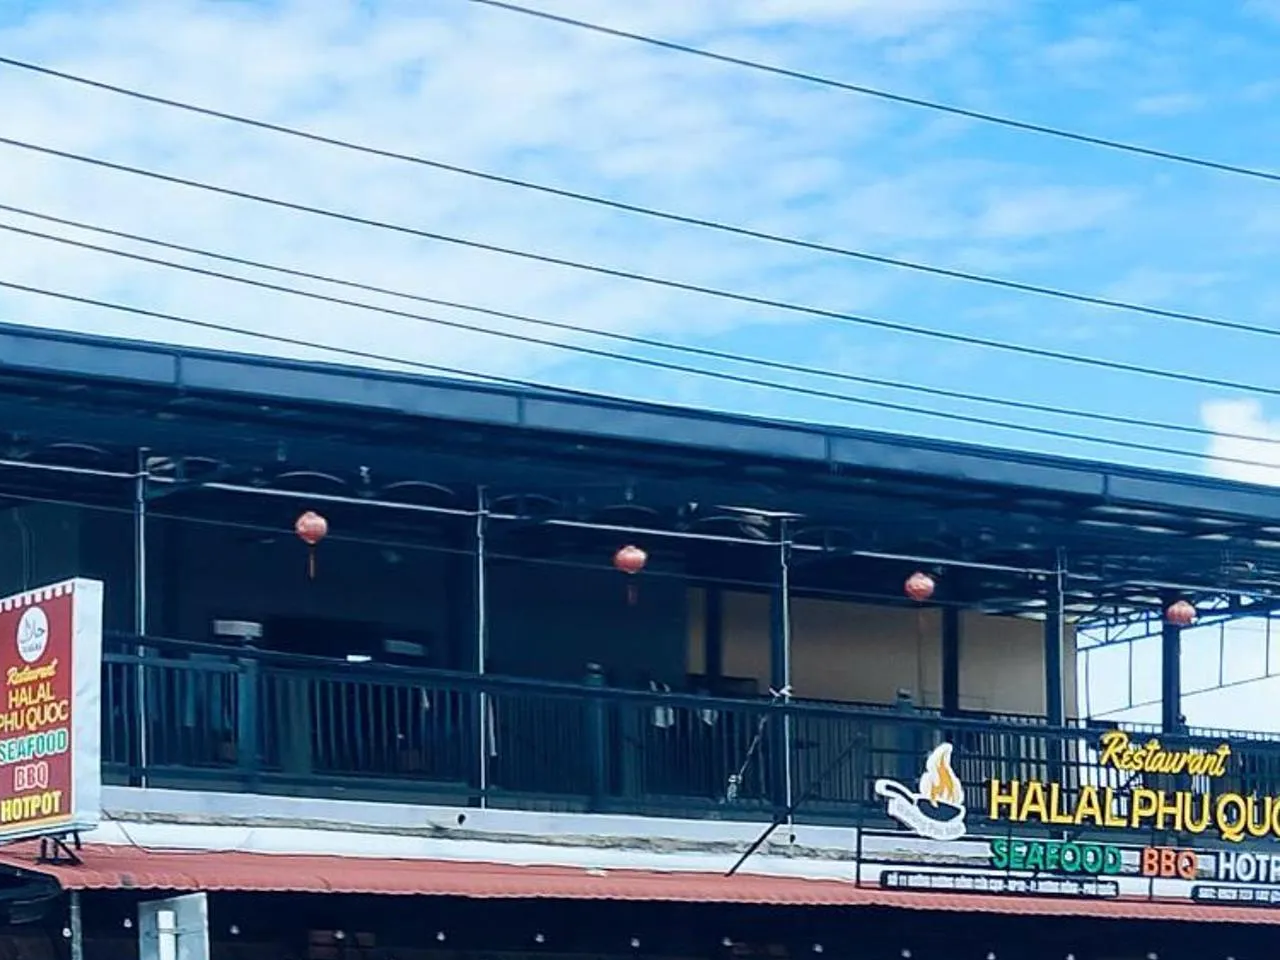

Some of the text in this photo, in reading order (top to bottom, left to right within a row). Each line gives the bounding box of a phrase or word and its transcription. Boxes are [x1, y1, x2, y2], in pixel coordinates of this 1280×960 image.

[8, 682, 55, 708] HALAL
[26, 699, 70, 731] QUOC
[1099, 728, 1231, 777] Restaurant
[14, 763, 48, 791] BBQ
[0, 792, 62, 822] HOTPOT
[990, 778, 1128, 828] HALAL
[1131, 787, 1210, 833] PHU
[990, 839, 1121, 875] SEAFOOD
[1142, 847, 1197, 880] BBQ
